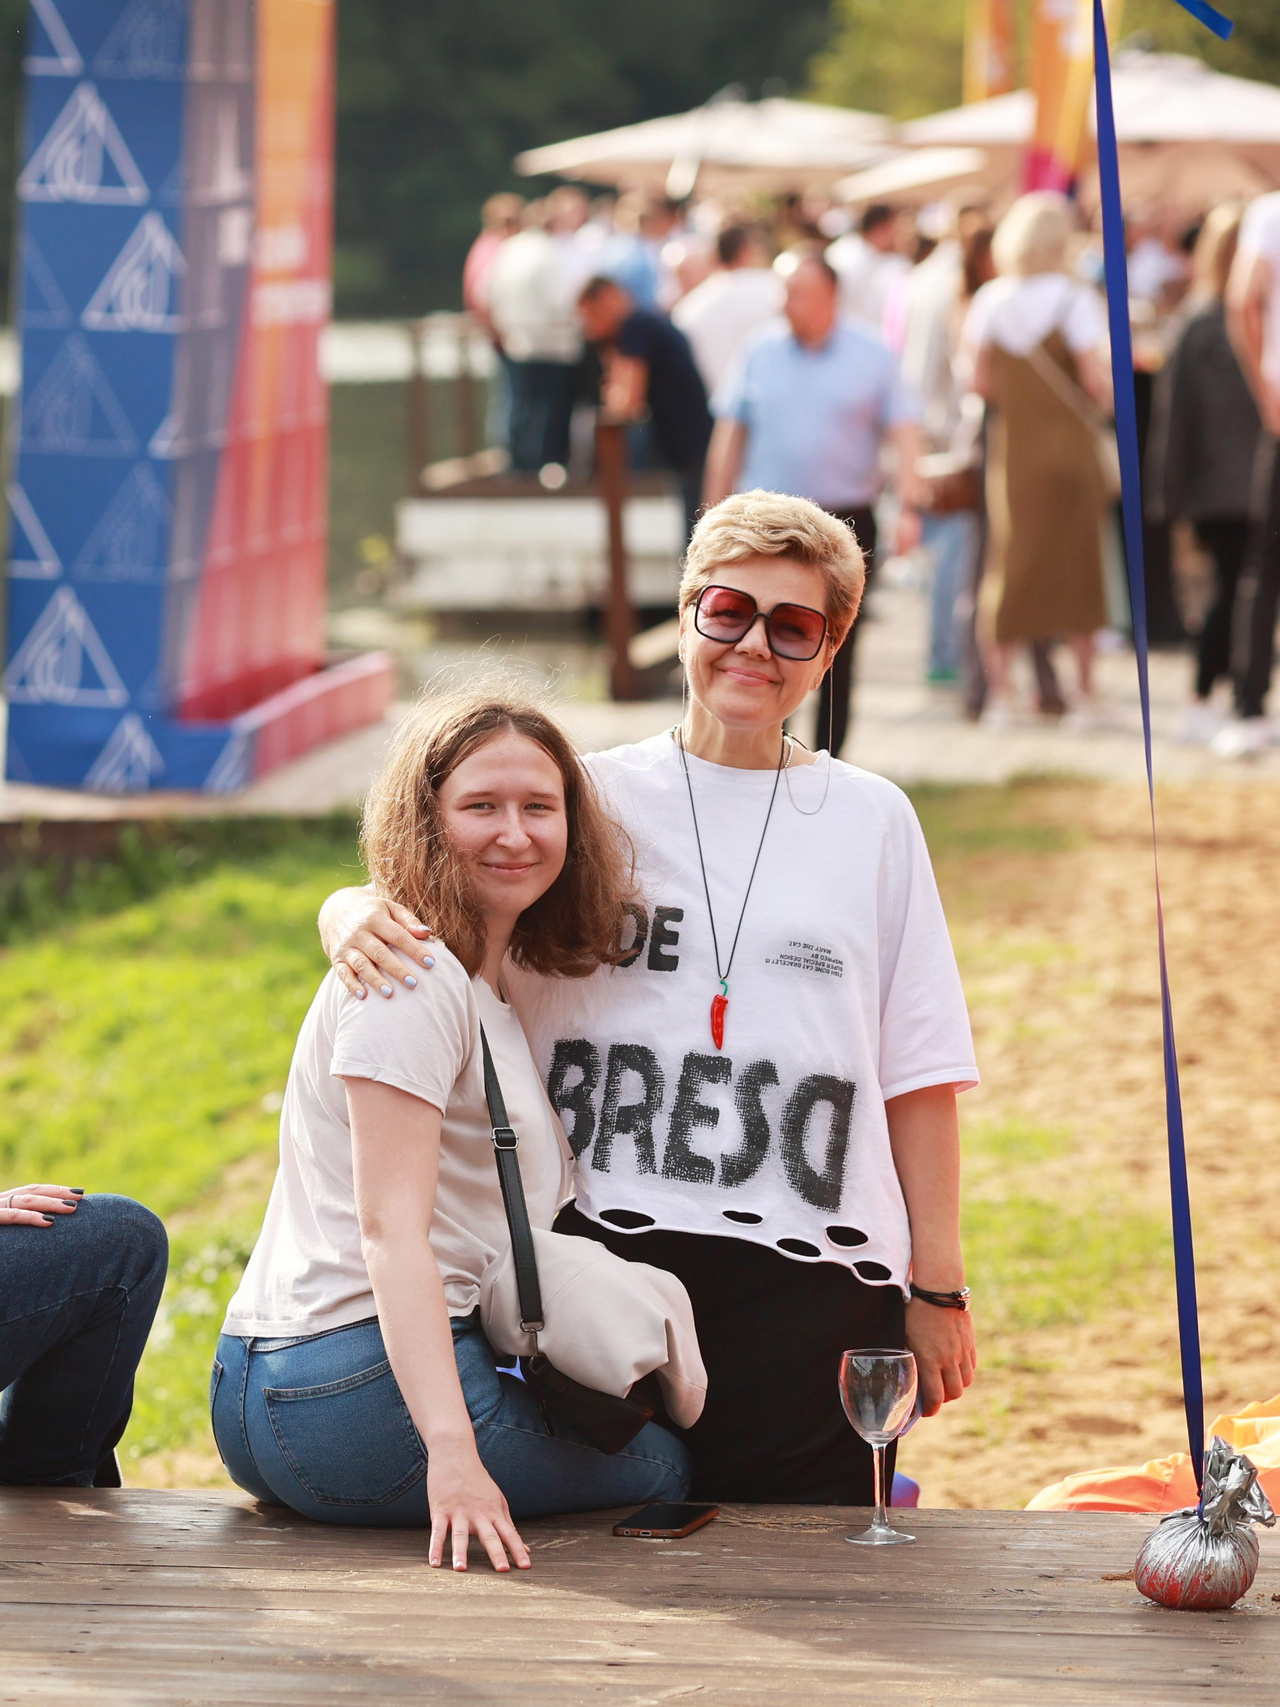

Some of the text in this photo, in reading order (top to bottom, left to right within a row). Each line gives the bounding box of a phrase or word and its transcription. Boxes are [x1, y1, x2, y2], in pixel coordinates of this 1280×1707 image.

[771, 958, 801, 968] BRACELET
[803, 958, 825, 967] SPECIAL
[820, 955, 843, 965] INSPIRED
[815, 966, 830, 974] BONE
[826, 963, 843, 971] SUPER
[831, 970, 843, 978] FISH
